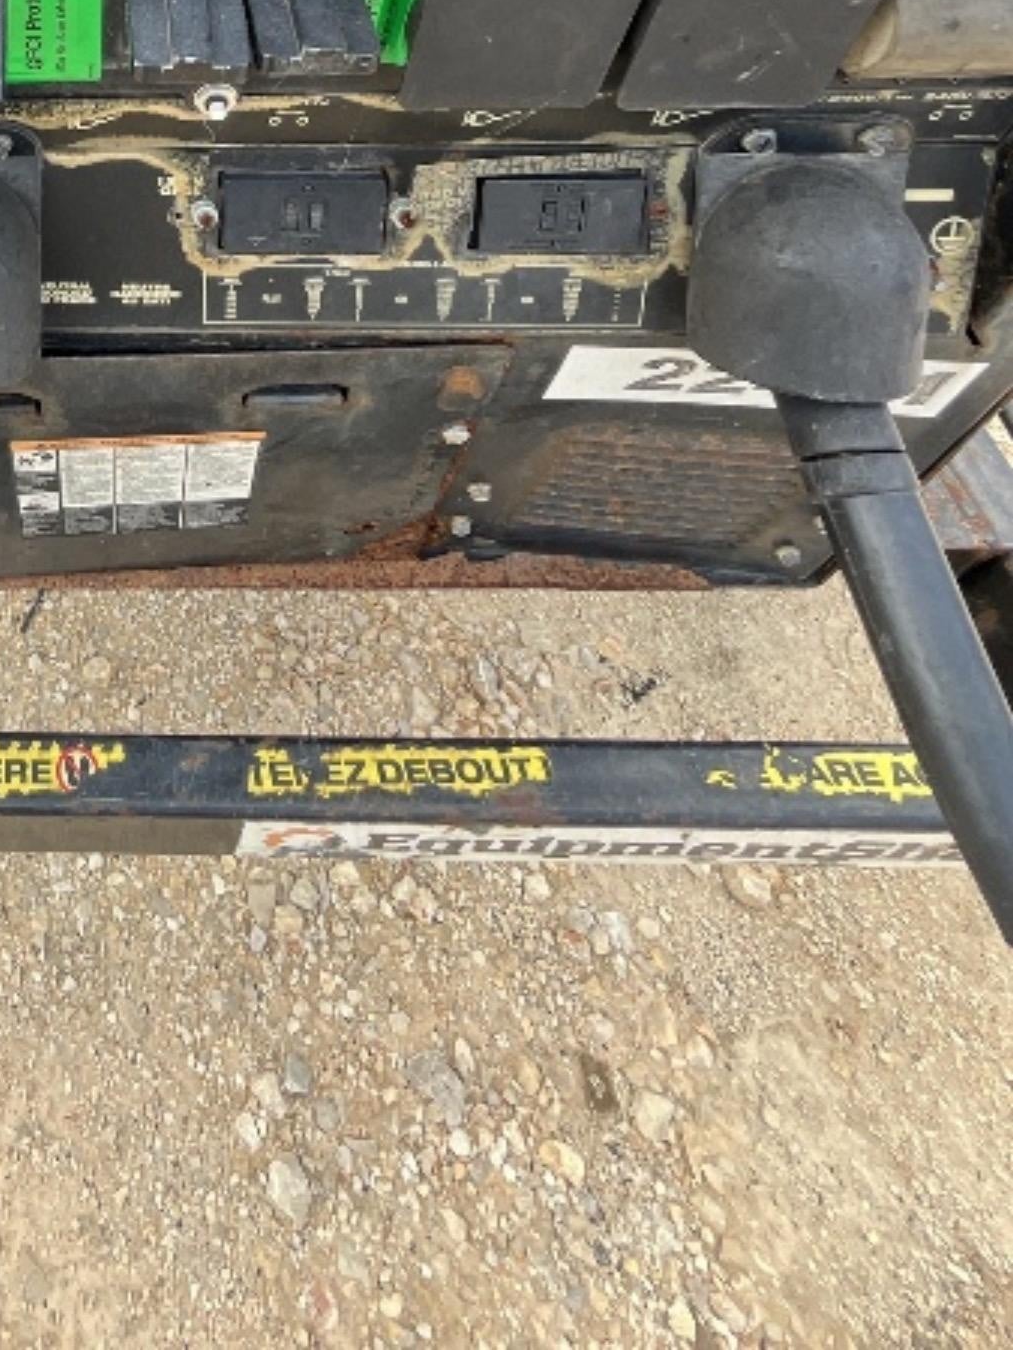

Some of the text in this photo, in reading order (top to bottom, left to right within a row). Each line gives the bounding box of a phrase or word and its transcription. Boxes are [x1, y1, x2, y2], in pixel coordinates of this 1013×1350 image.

[24, 34, 44, 71] GFCI
[377, 757, 530, 785] DEBOUT
[800, 758, 885, 787] ARE
